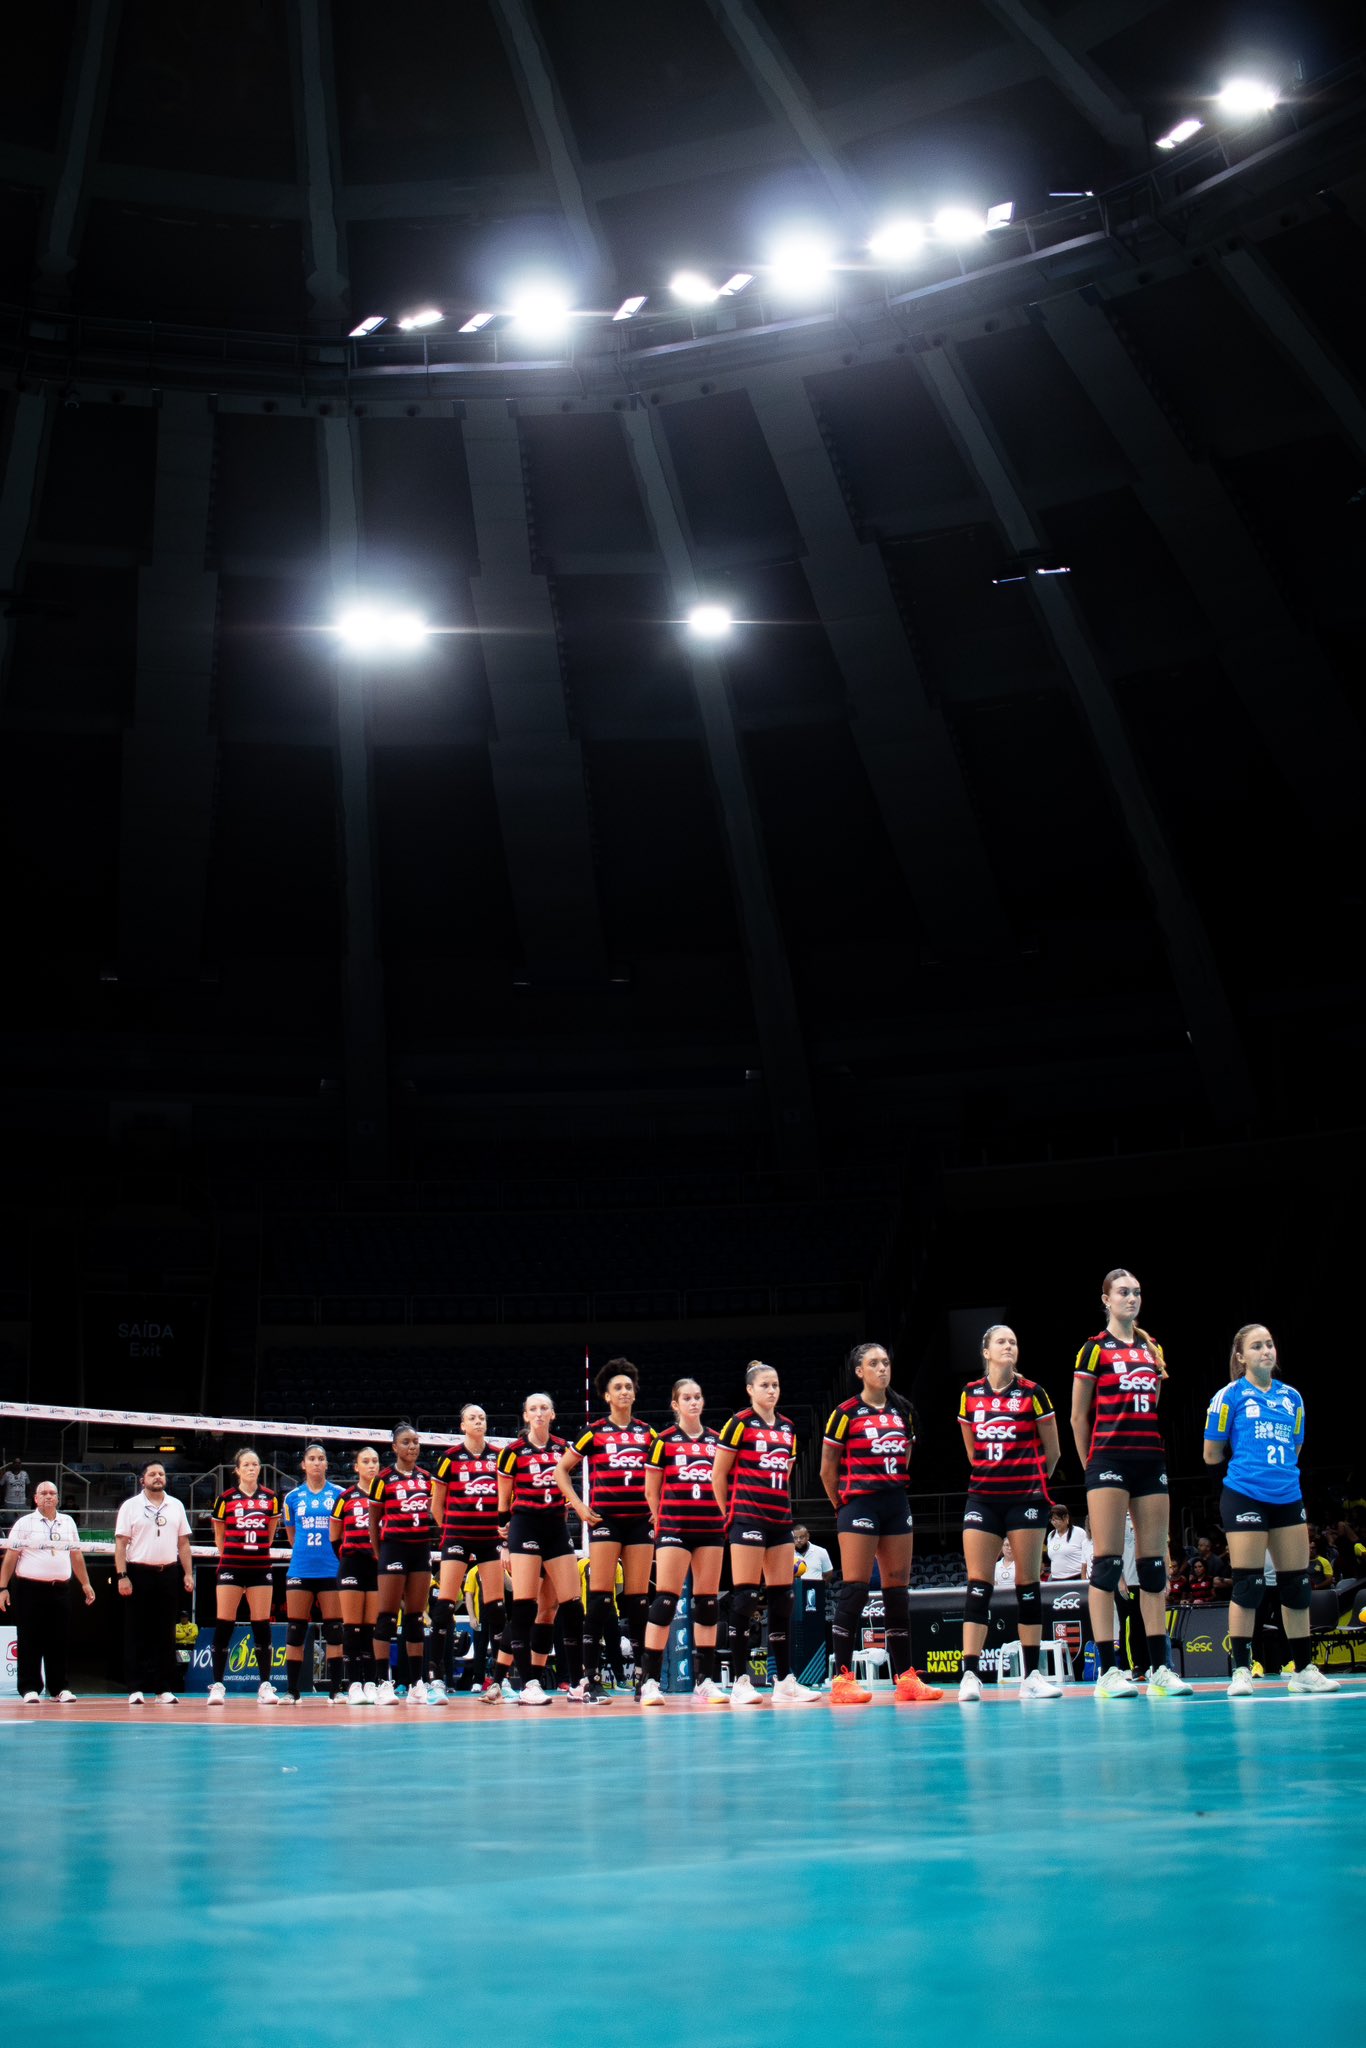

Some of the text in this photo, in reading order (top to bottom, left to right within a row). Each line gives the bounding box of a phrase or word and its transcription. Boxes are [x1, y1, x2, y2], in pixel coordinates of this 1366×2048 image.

[118, 1320, 174, 1338] SAÍDA
[130, 1342, 161, 1357] Exit
[1119, 1375, 1156, 1390] Sesc
[1133, 1394, 1150, 1412] 15
[976, 1423, 1016, 1439] Sesc
[1275, 1422, 1292, 1432] SESC
[871, 1439, 906, 1453] Sesc
[986, 1442, 1003, 1460] 13
[608, 1454, 644, 1468] Sesc
[1267, 1445, 1285, 1464] 21
[883, 1457, 897, 1474] 12
[624, 1471, 633, 1486] 7
[770, 1472, 783, 1489] 11
[464, 1482, 496, 1495] Sesc
[692, 1483, 701, 1499] 8
[544, 1489, 552, 1504] 6
[475, 1497, 483, 1511] 4
[236, 1518, 265, 1528] Sesc
[413, 1514, 420, 1527] 3
[1236, 1514, 1262, 1523] Sesc
[245, 1531, 256, 1543] 10
[307, 1533, 322, 1546] 22
[1052, 1597, 1081, 1609] Sesc
[1186, 1641, 1213, 1653] Sesc
[927, 1661, 959, 1673] MAIS
